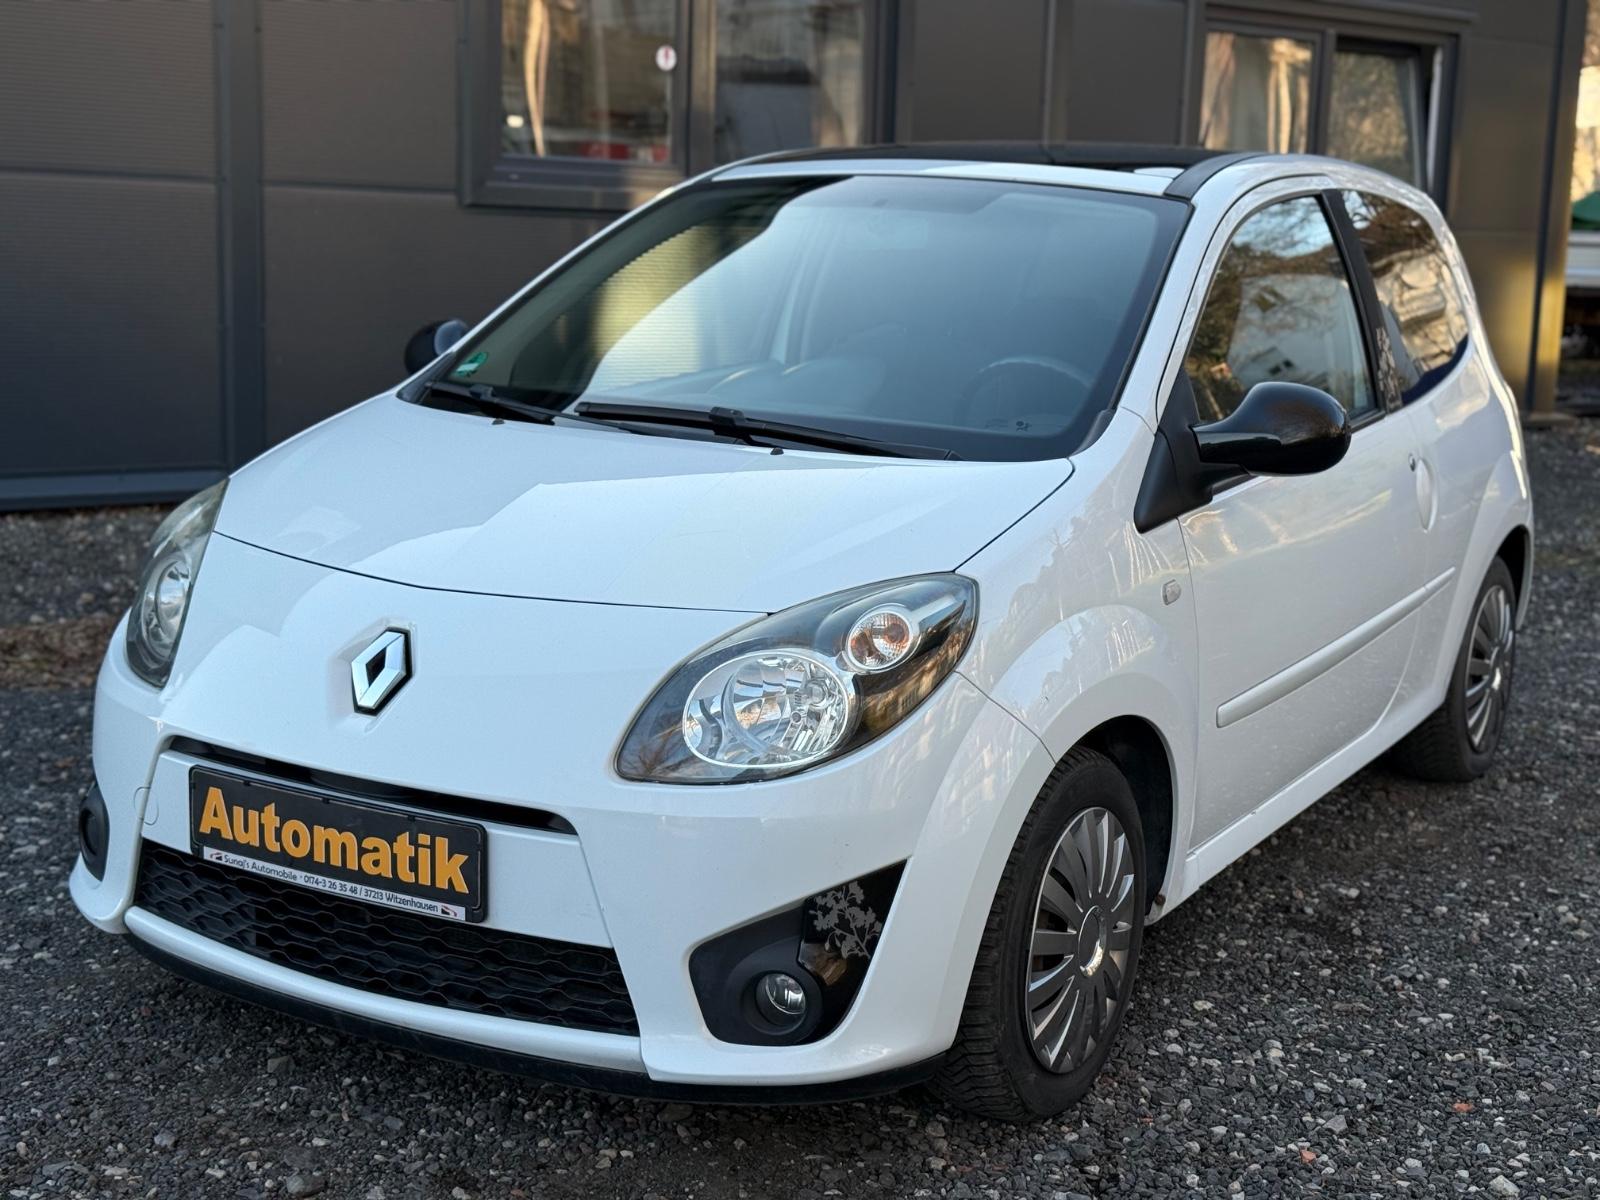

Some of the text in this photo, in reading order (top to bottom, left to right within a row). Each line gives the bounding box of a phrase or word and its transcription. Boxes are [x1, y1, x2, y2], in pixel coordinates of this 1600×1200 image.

[199, 786, 469, 893] Automatik
[224, 854, 250, 870] Sunaj's
[251, 862, 298, 881] Automobile
[303, 875, 327, 888] 0174-3
[327, 881, 337, 890] 26
[338, 883, 347, 893] 35
[364, 888, 384, 901] 37213
[385, 892, 438, 911] Witzenhausen
